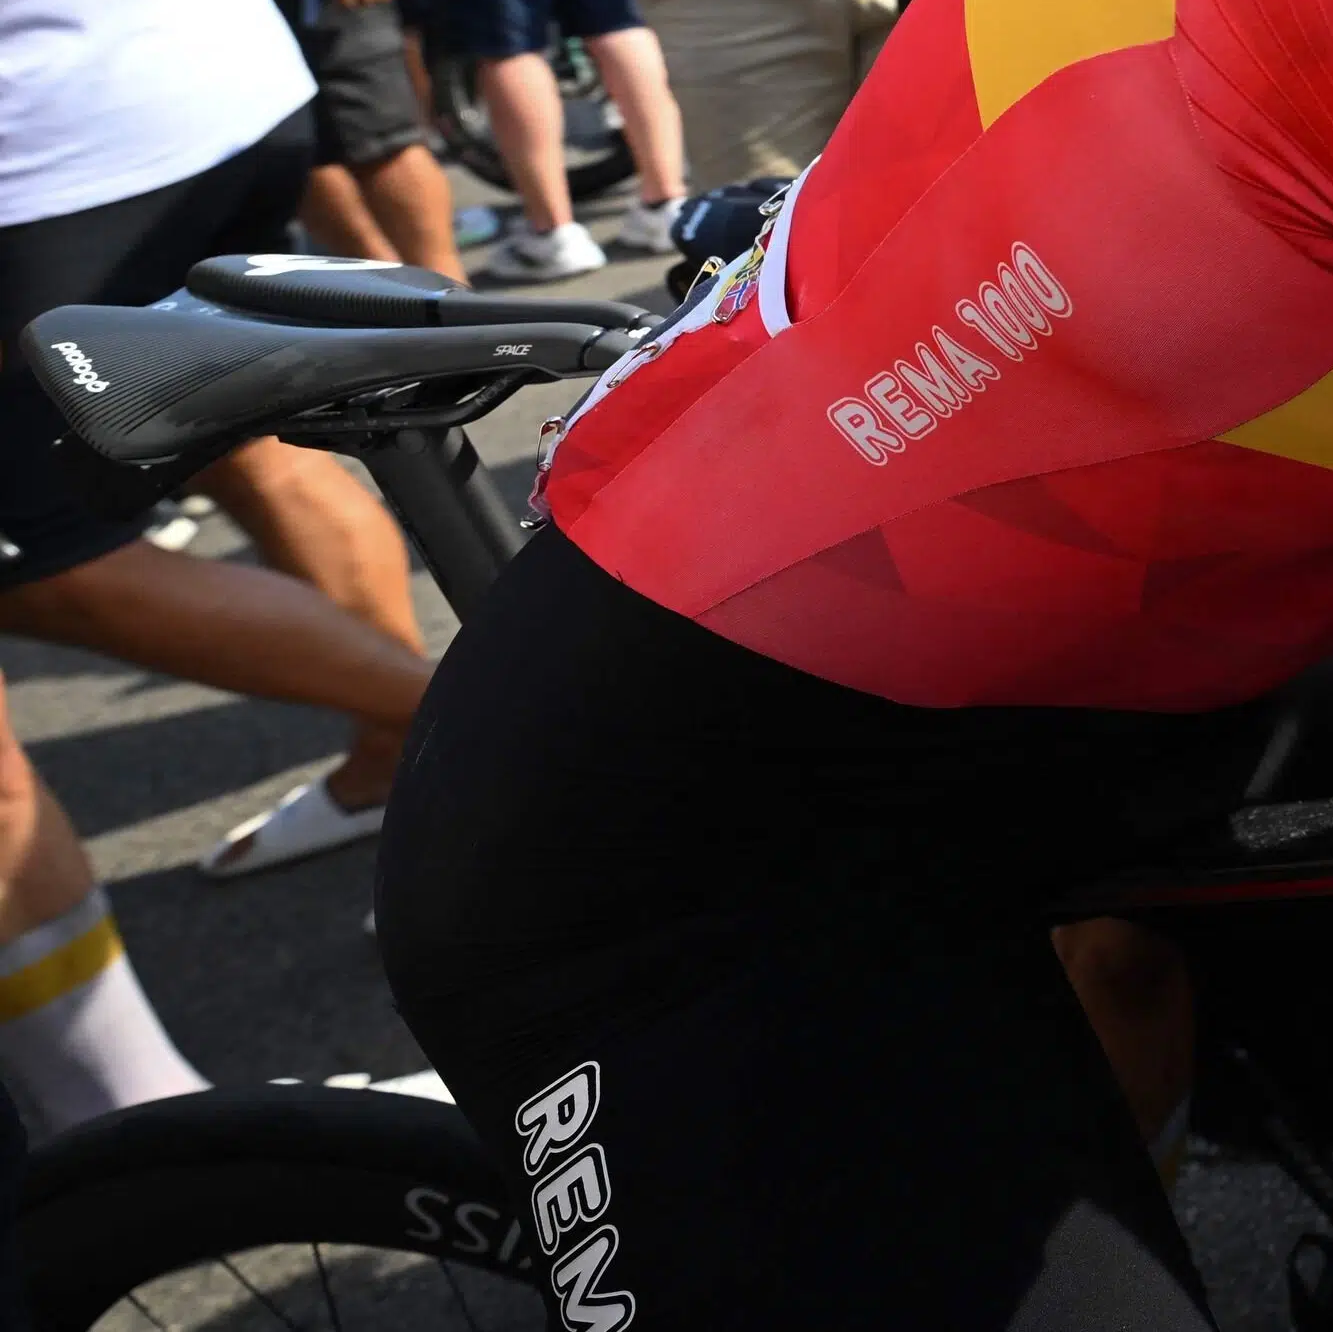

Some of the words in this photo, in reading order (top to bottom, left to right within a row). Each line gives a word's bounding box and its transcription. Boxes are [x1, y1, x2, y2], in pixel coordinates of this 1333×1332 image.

[51, 341, 110, 394] prologo
[494, 343, 533, 357] SPACE
[827, 325, 1001, 466] REMA
[956, 241, 1074, 362] 1000
